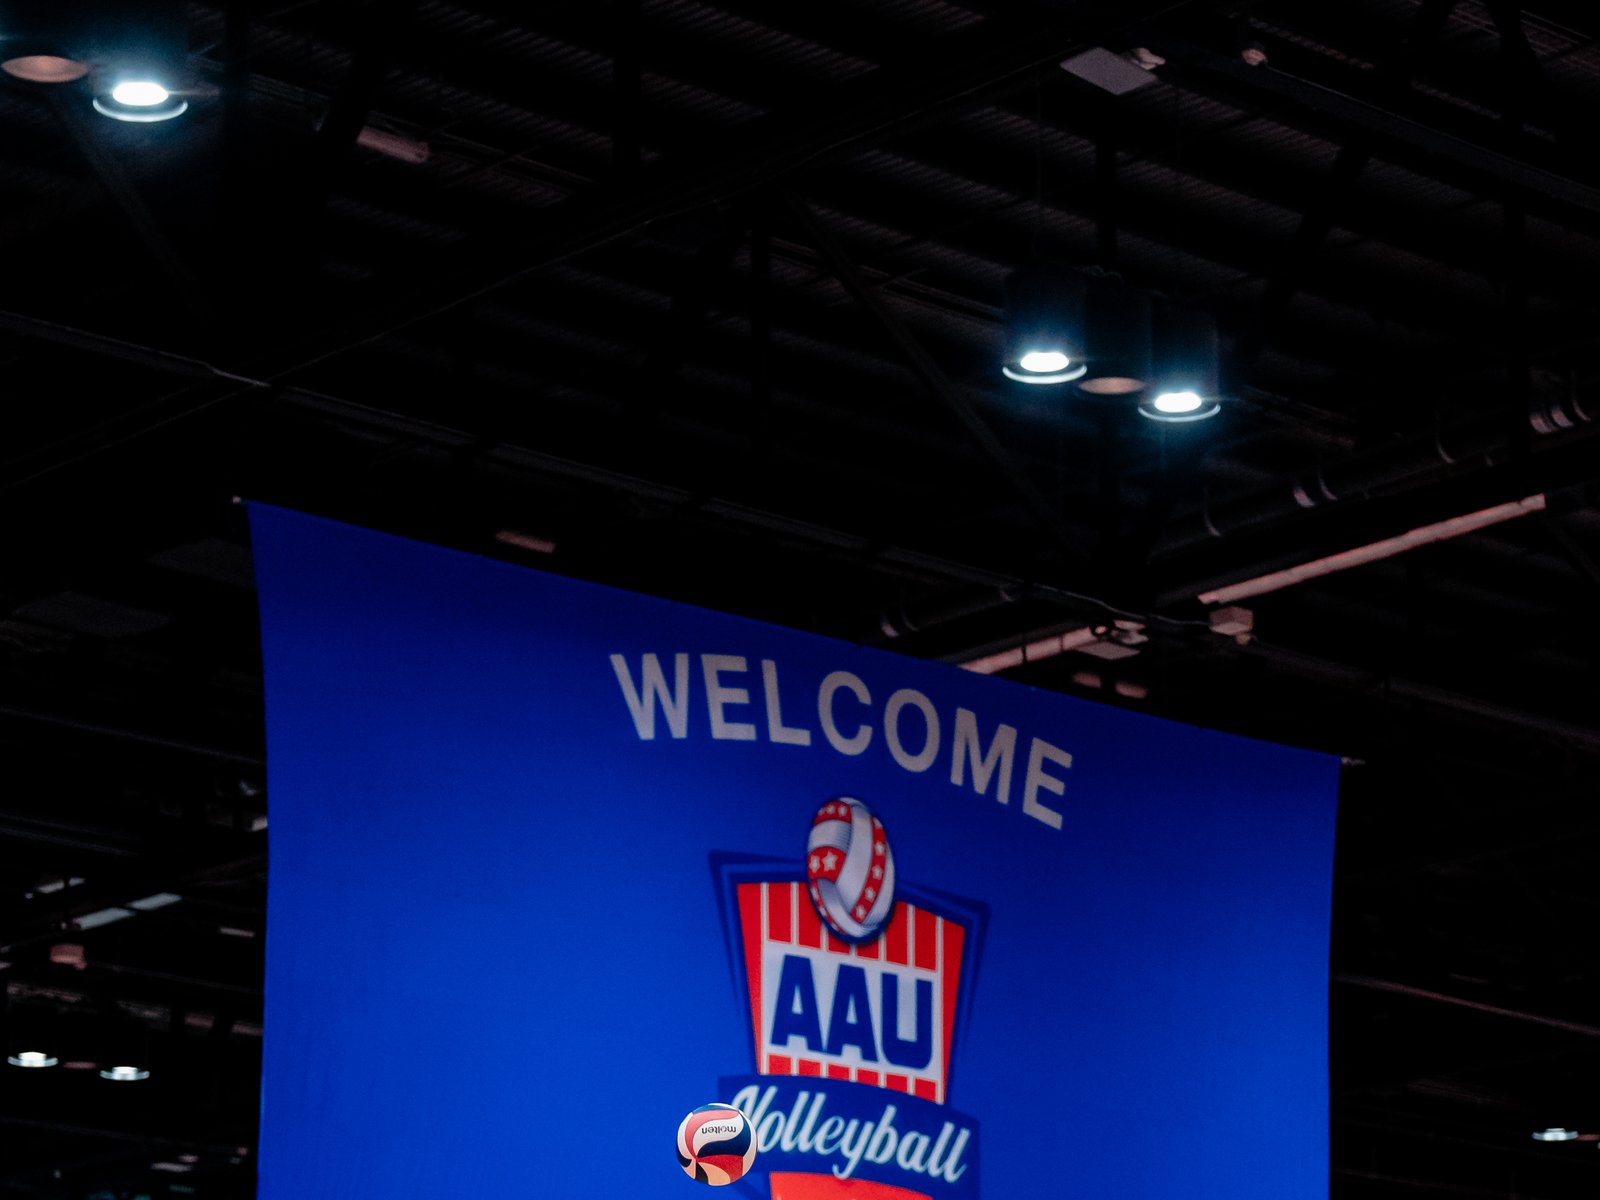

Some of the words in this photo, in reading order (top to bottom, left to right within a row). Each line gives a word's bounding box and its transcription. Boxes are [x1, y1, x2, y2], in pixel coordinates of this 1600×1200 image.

[609, 653, 1072, 830] WELCOME
[771, 954, 932, 1070] AAU
[701, 1126, 737, 1134] molten
[729, 1085, 971, 1182] Volleyball
